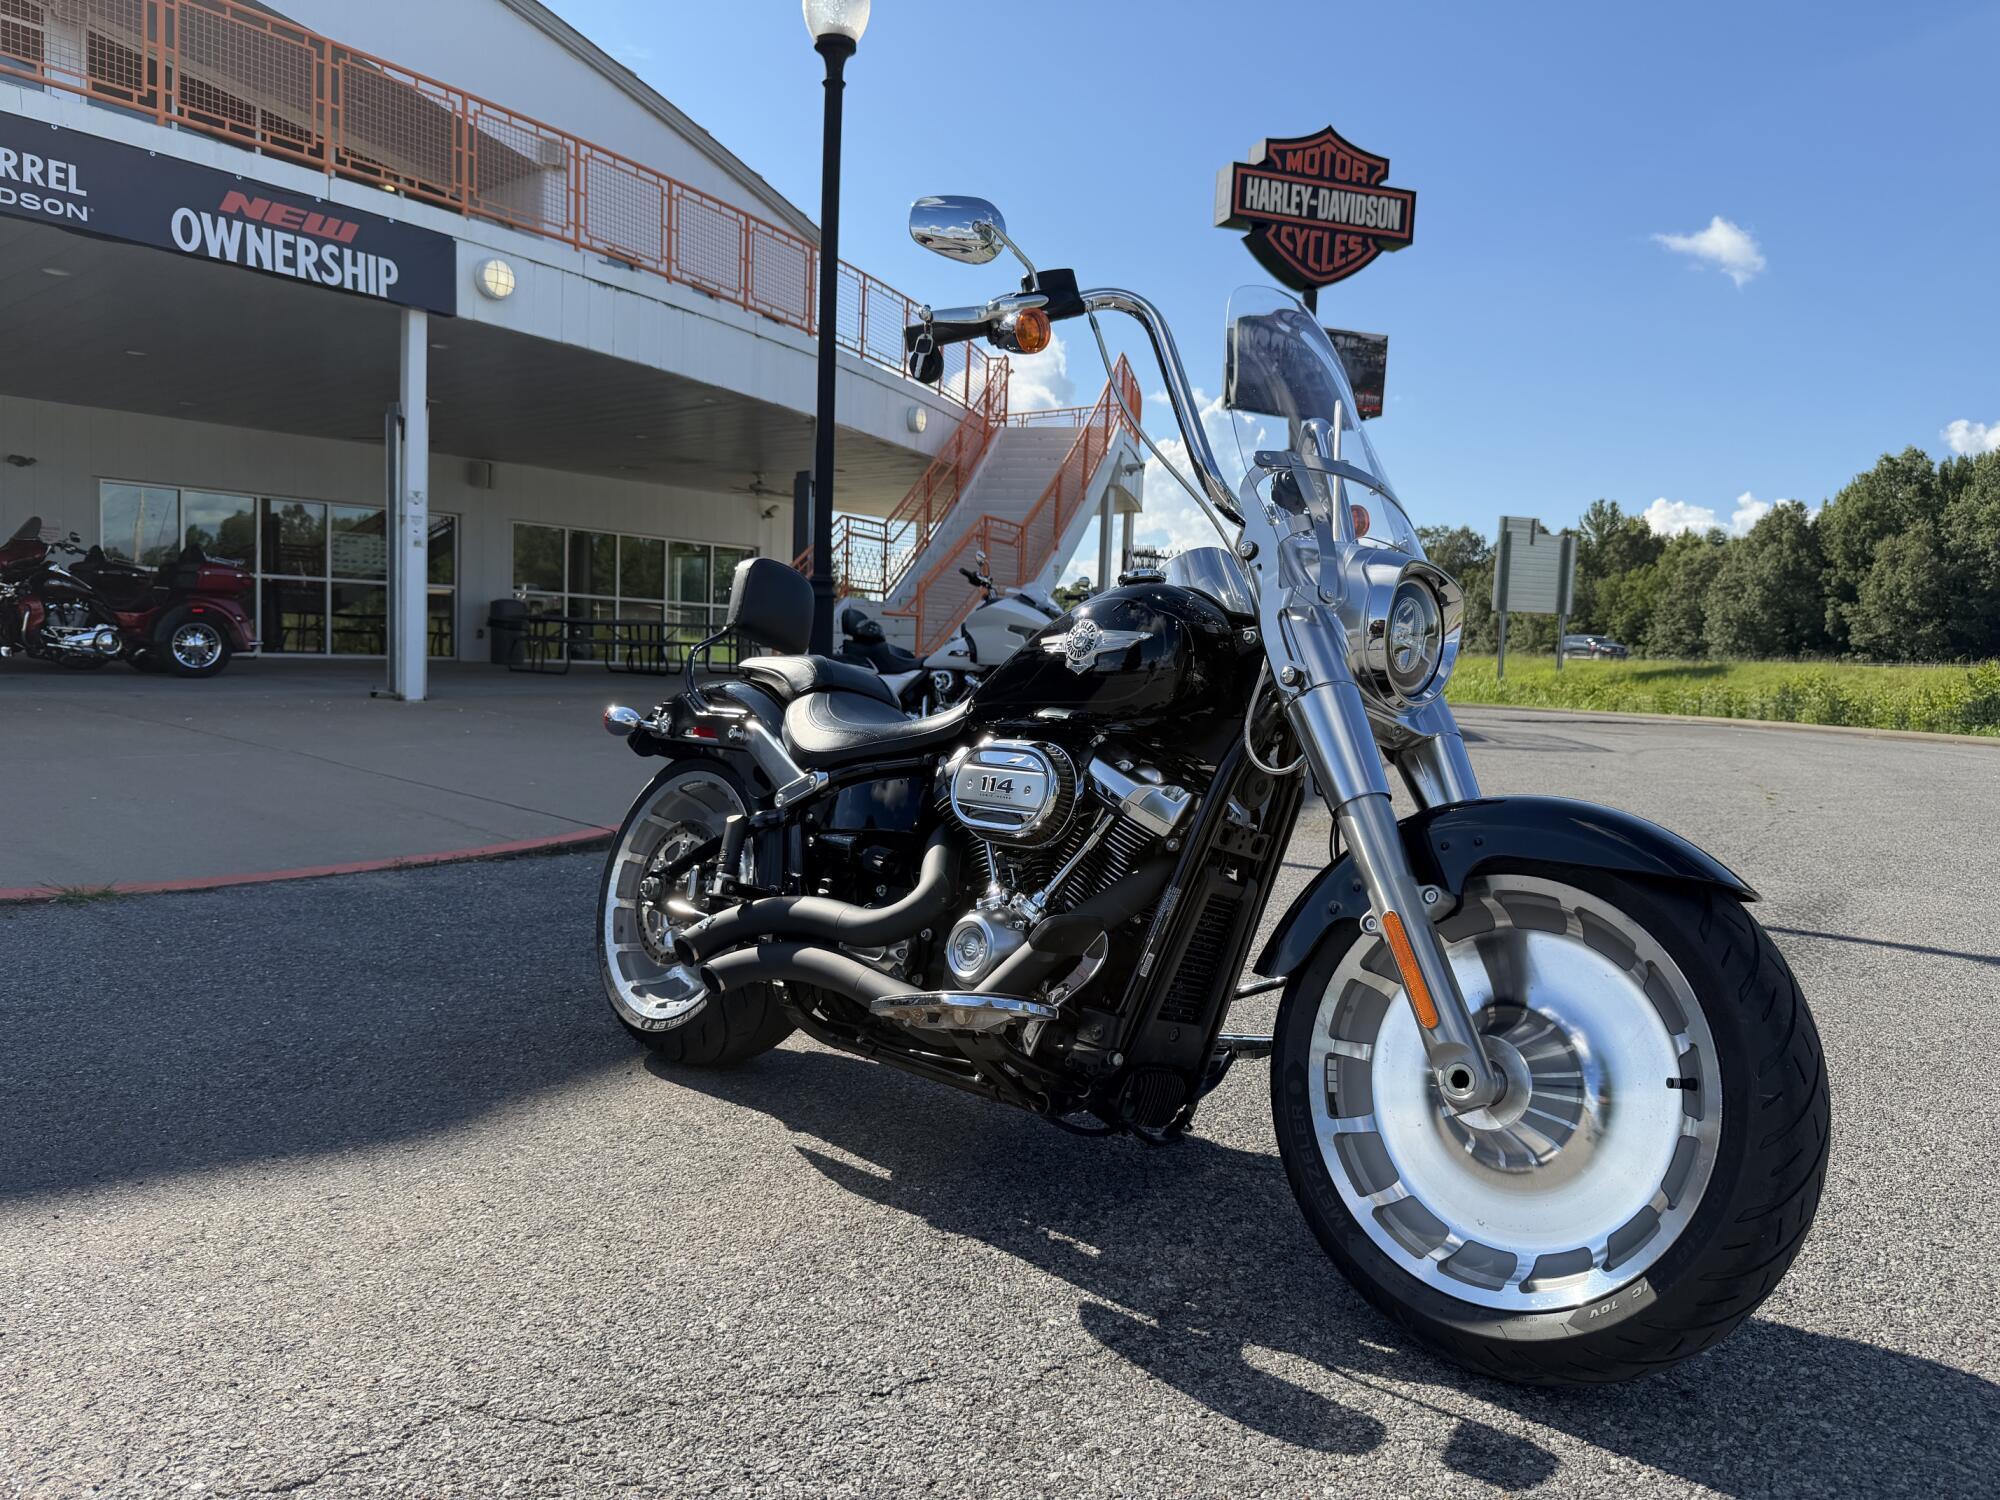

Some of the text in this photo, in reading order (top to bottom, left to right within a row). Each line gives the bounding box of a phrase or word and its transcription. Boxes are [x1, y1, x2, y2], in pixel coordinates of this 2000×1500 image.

[0, 146, 88, 197] RREL
[1286, 145, 1368, 184] MOTOR
[0, 187, 88, 222] DSON
[217, 190, 360, 244] NEW
[1246, 176, 1402, 231] HARLEY-DAVIDSON
[171, 207, 399, 298] OWNERSHIP
[1280, 226, 1365, 273] CYCLES
[980, 774, 1015, 793] 114
[1291, 1104, 1348, 1230] METZELER
[1589, 1300, 1618, 1319] 70V
